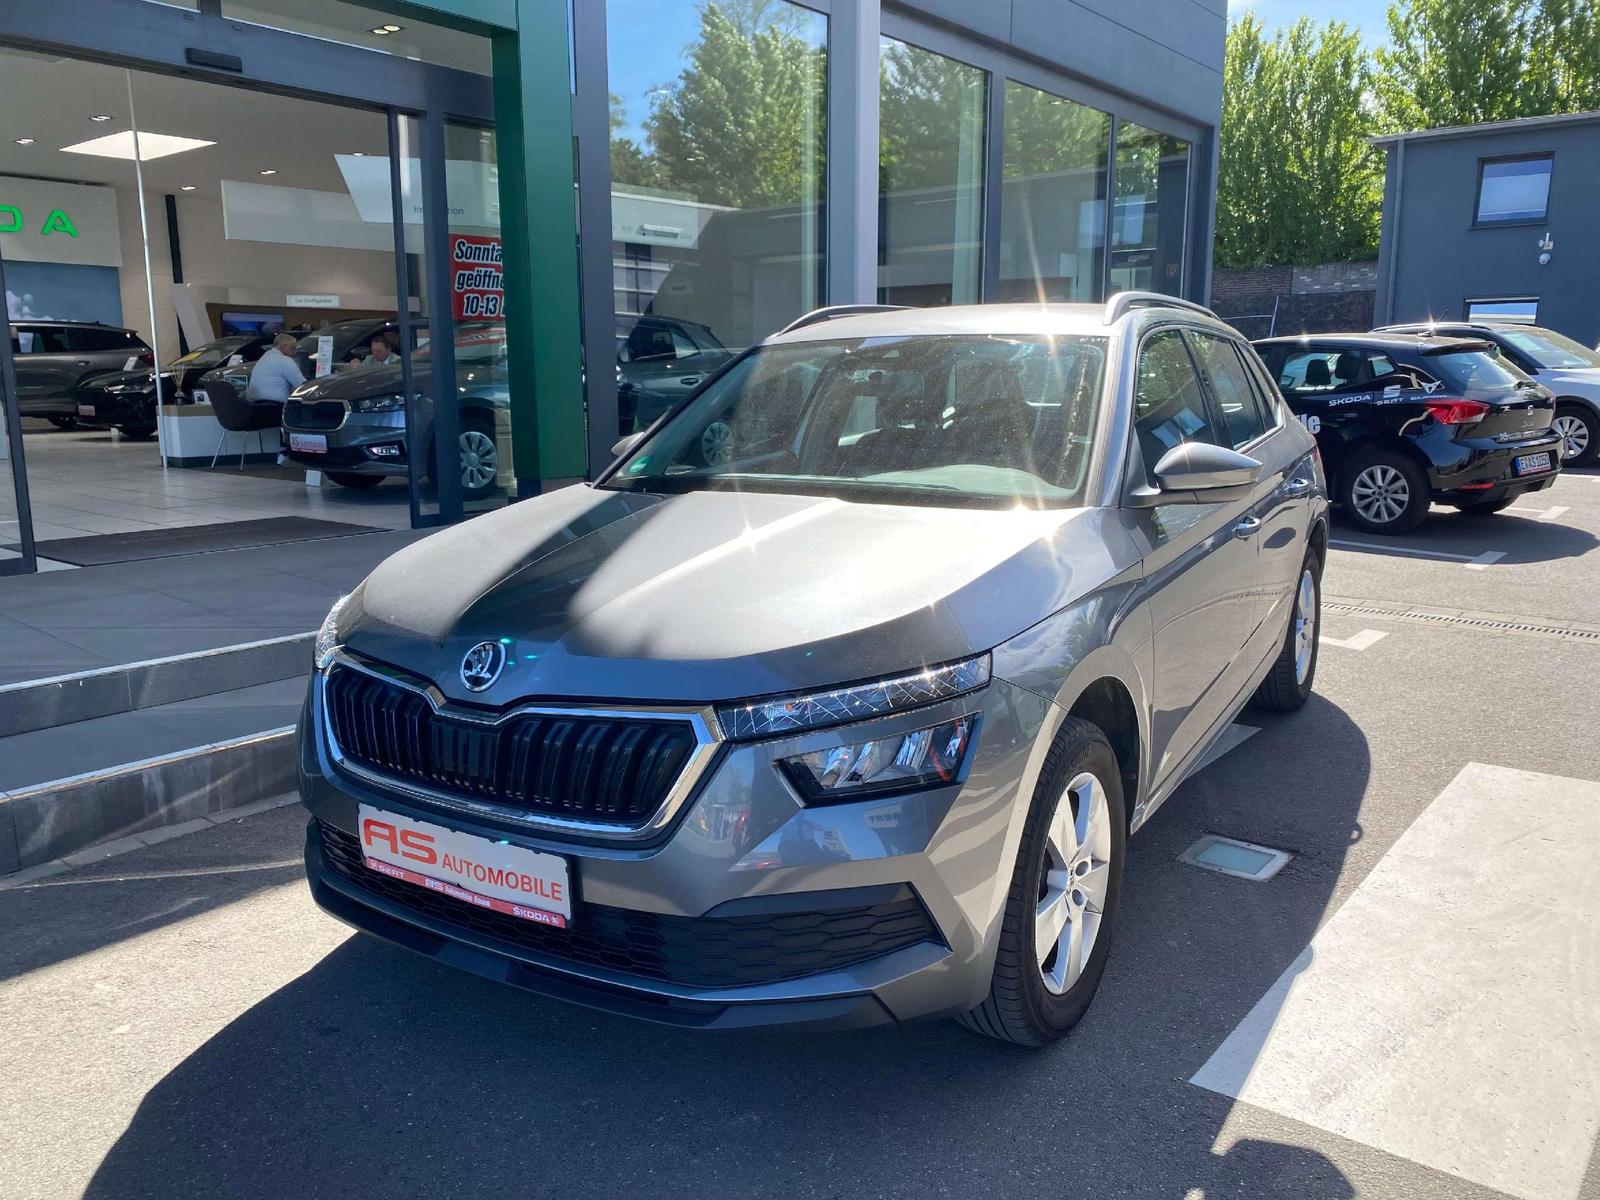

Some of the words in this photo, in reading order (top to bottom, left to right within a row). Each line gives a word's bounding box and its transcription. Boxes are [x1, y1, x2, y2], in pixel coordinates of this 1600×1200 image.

[455, 240, 503, 263] Sonnta
[463, 294, 499, 316] 10-13
[363, 818, 438, 865] AS
[442, 853, 563, 901] AUTOMOBILE
[379, 865, 405, 879] SEAT
[512, 905, 550, 922] ŠKODA
